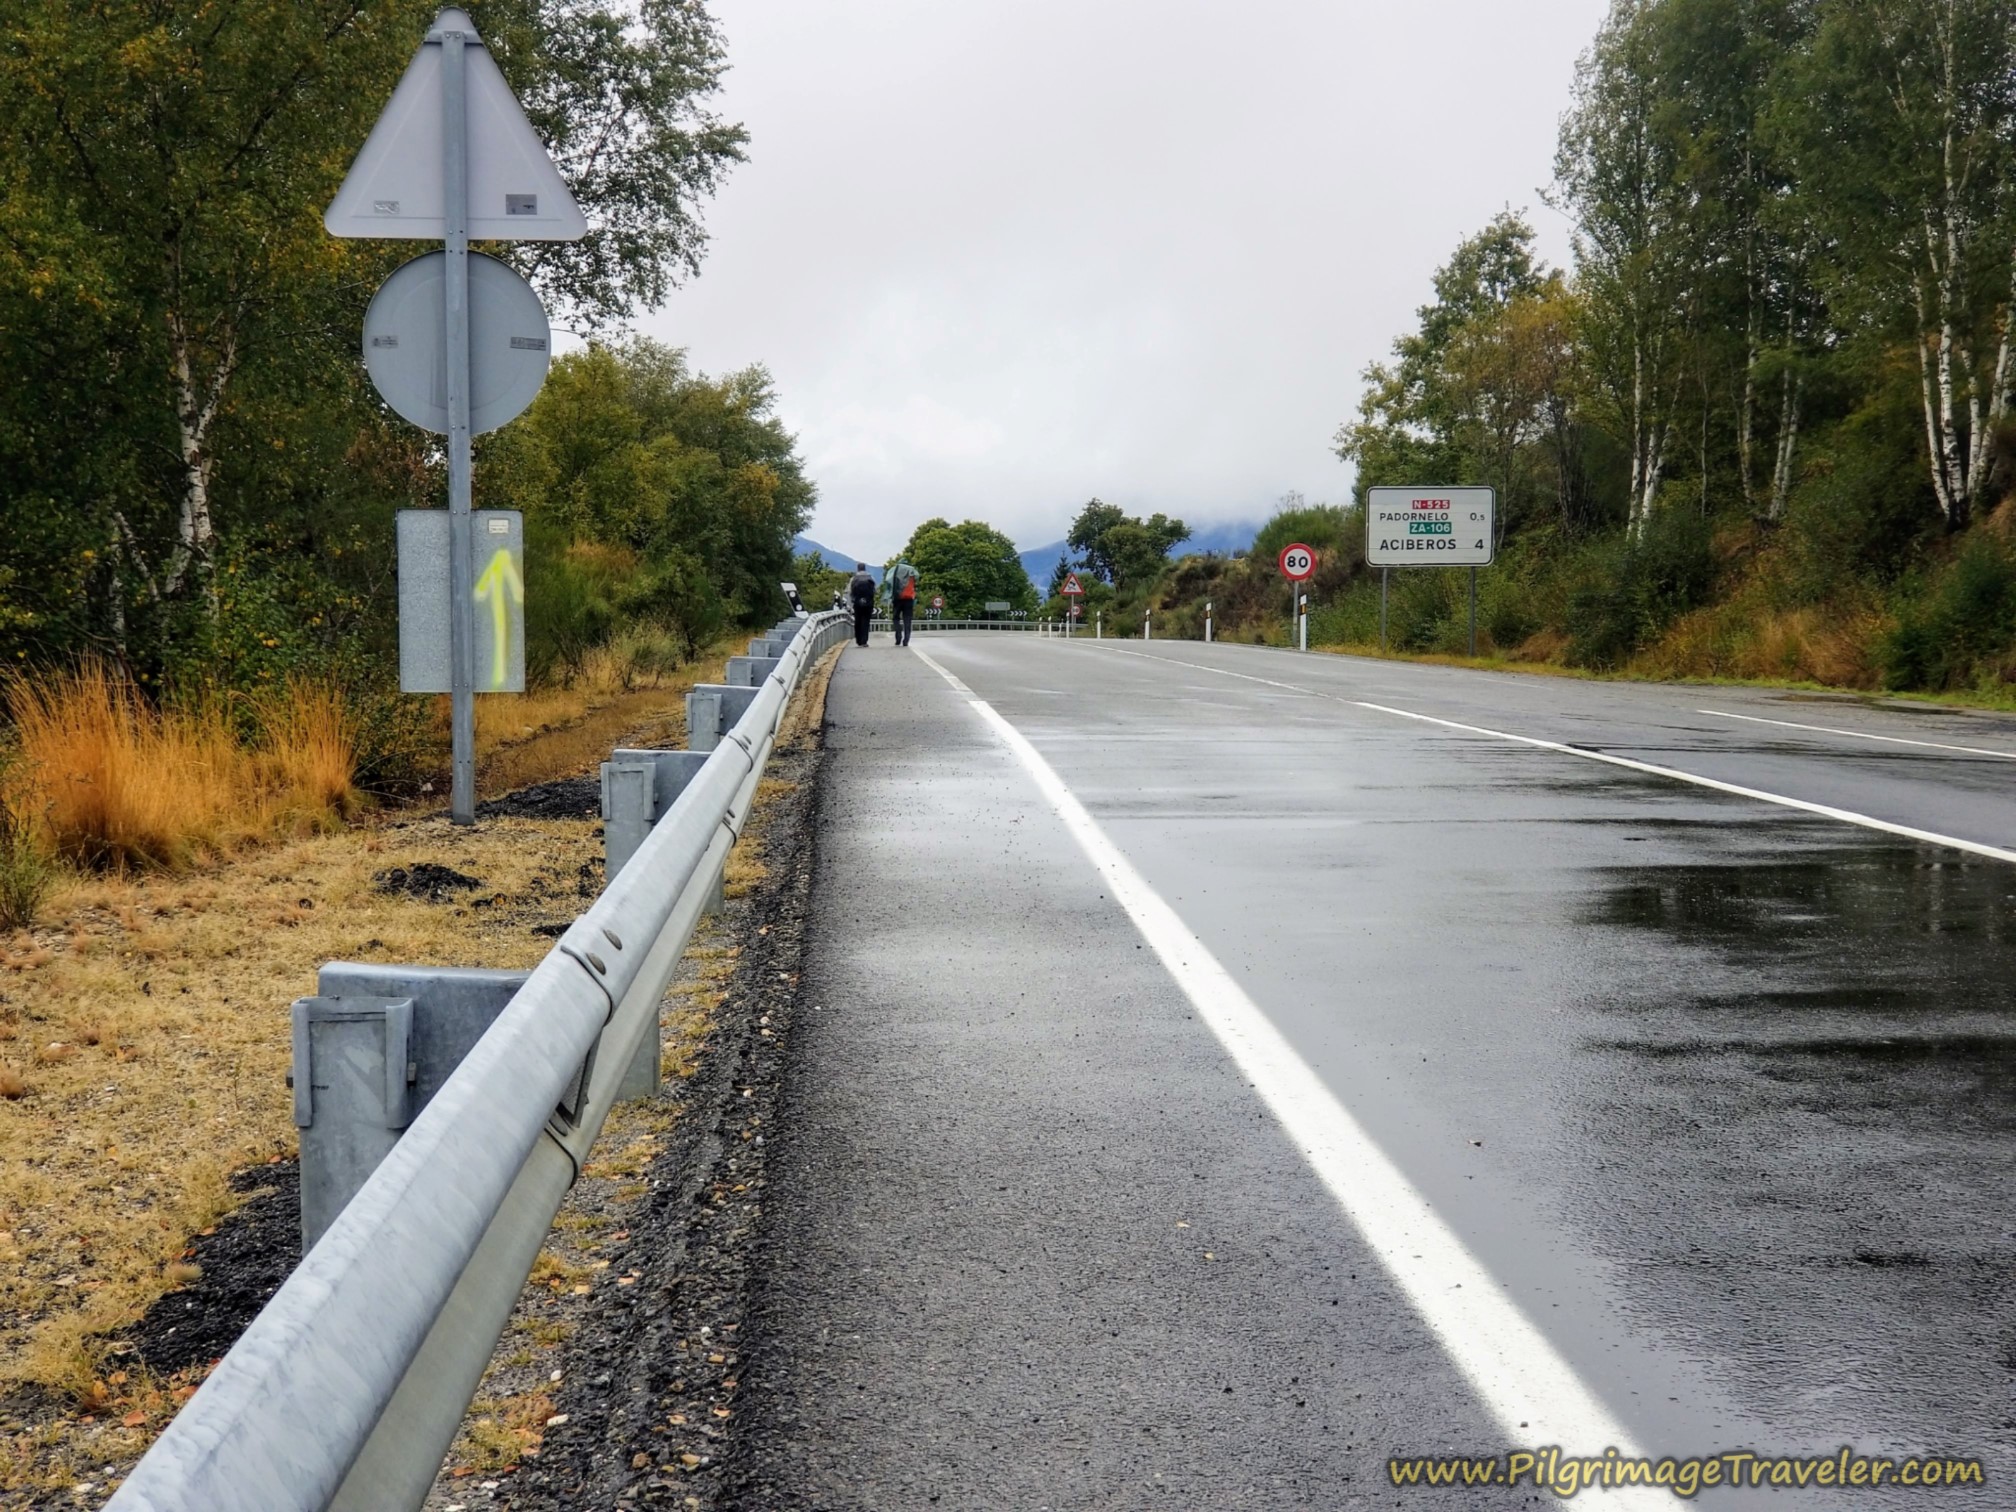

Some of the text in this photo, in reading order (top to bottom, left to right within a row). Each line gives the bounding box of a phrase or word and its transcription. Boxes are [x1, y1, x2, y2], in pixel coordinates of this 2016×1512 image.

[1413, 500, 1449, 509] N-525
[1380, 512, 1449, 521] PADORNELO
[1411, 523, 1451, 533] ZA-106
[1379, 539, 1484, 550] ACIBEROS 4
[1287, 556, 1309, 568] 80
